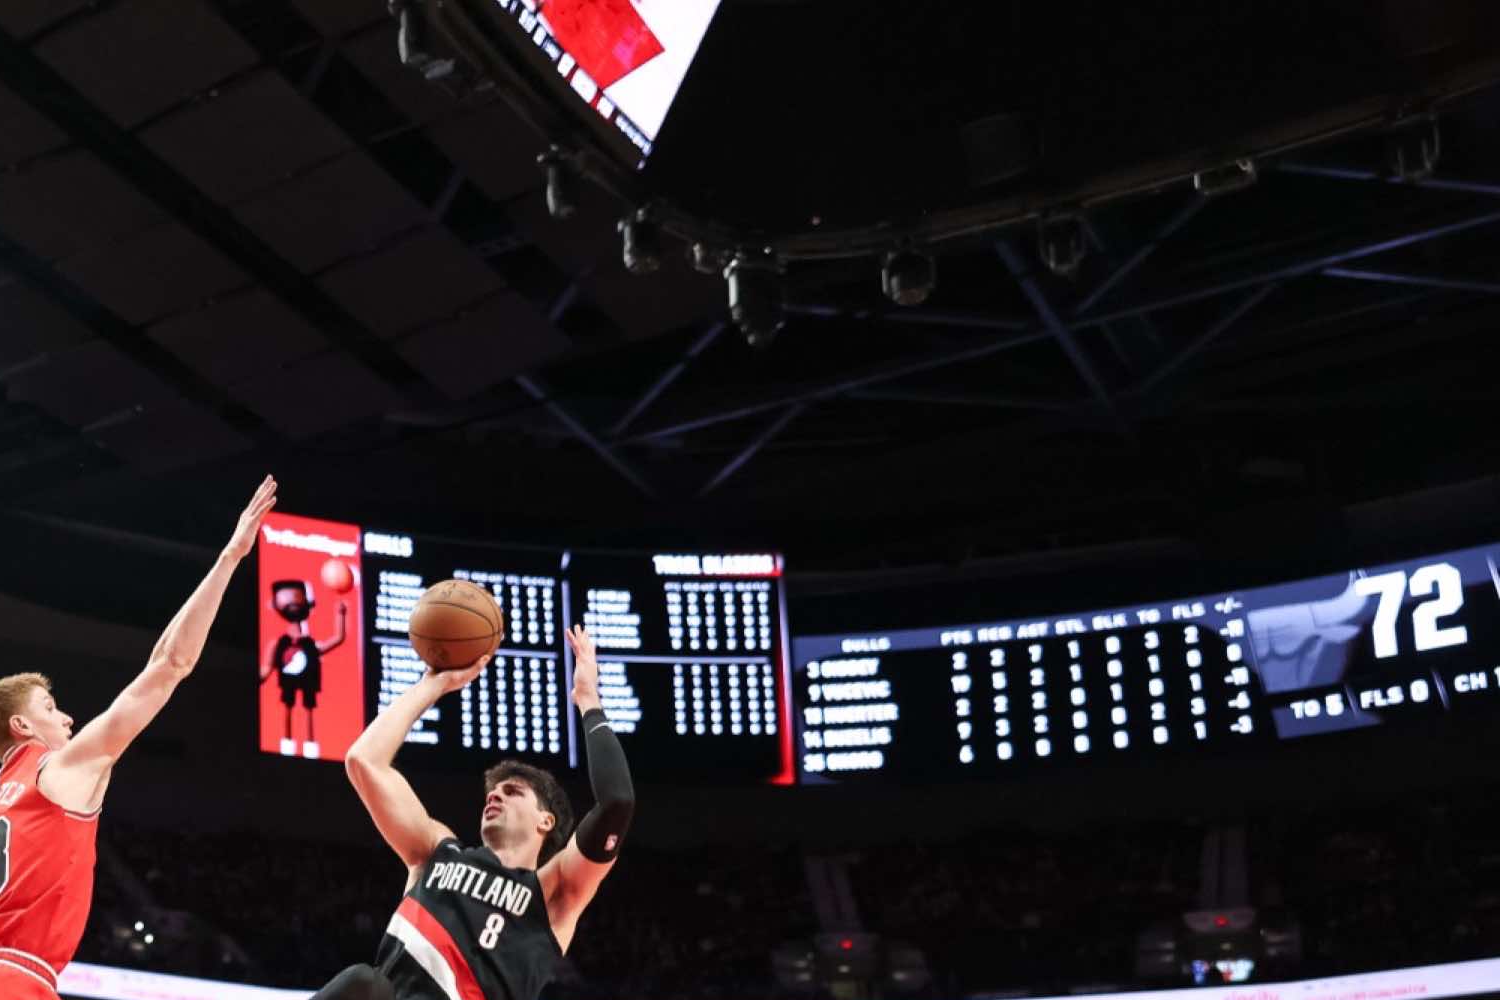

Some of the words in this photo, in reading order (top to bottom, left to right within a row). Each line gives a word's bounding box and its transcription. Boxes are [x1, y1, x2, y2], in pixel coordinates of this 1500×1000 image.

[940, 631, 973, 645] PTS
[1016, 622, 1048, 639] AST
[1136, 610, 1161, 623] TO
[1355, 563, 1466, 658] 72
[1289, 700, 1321, 718] TO
[1325, 694, 1345, 716] 5
[1359, 686, 1405, 708] FLS
[1454, 672, 1488, 692] CH
[426, 860, 531, 917] PORTLAND
[479, 913, 504, 950] 8
